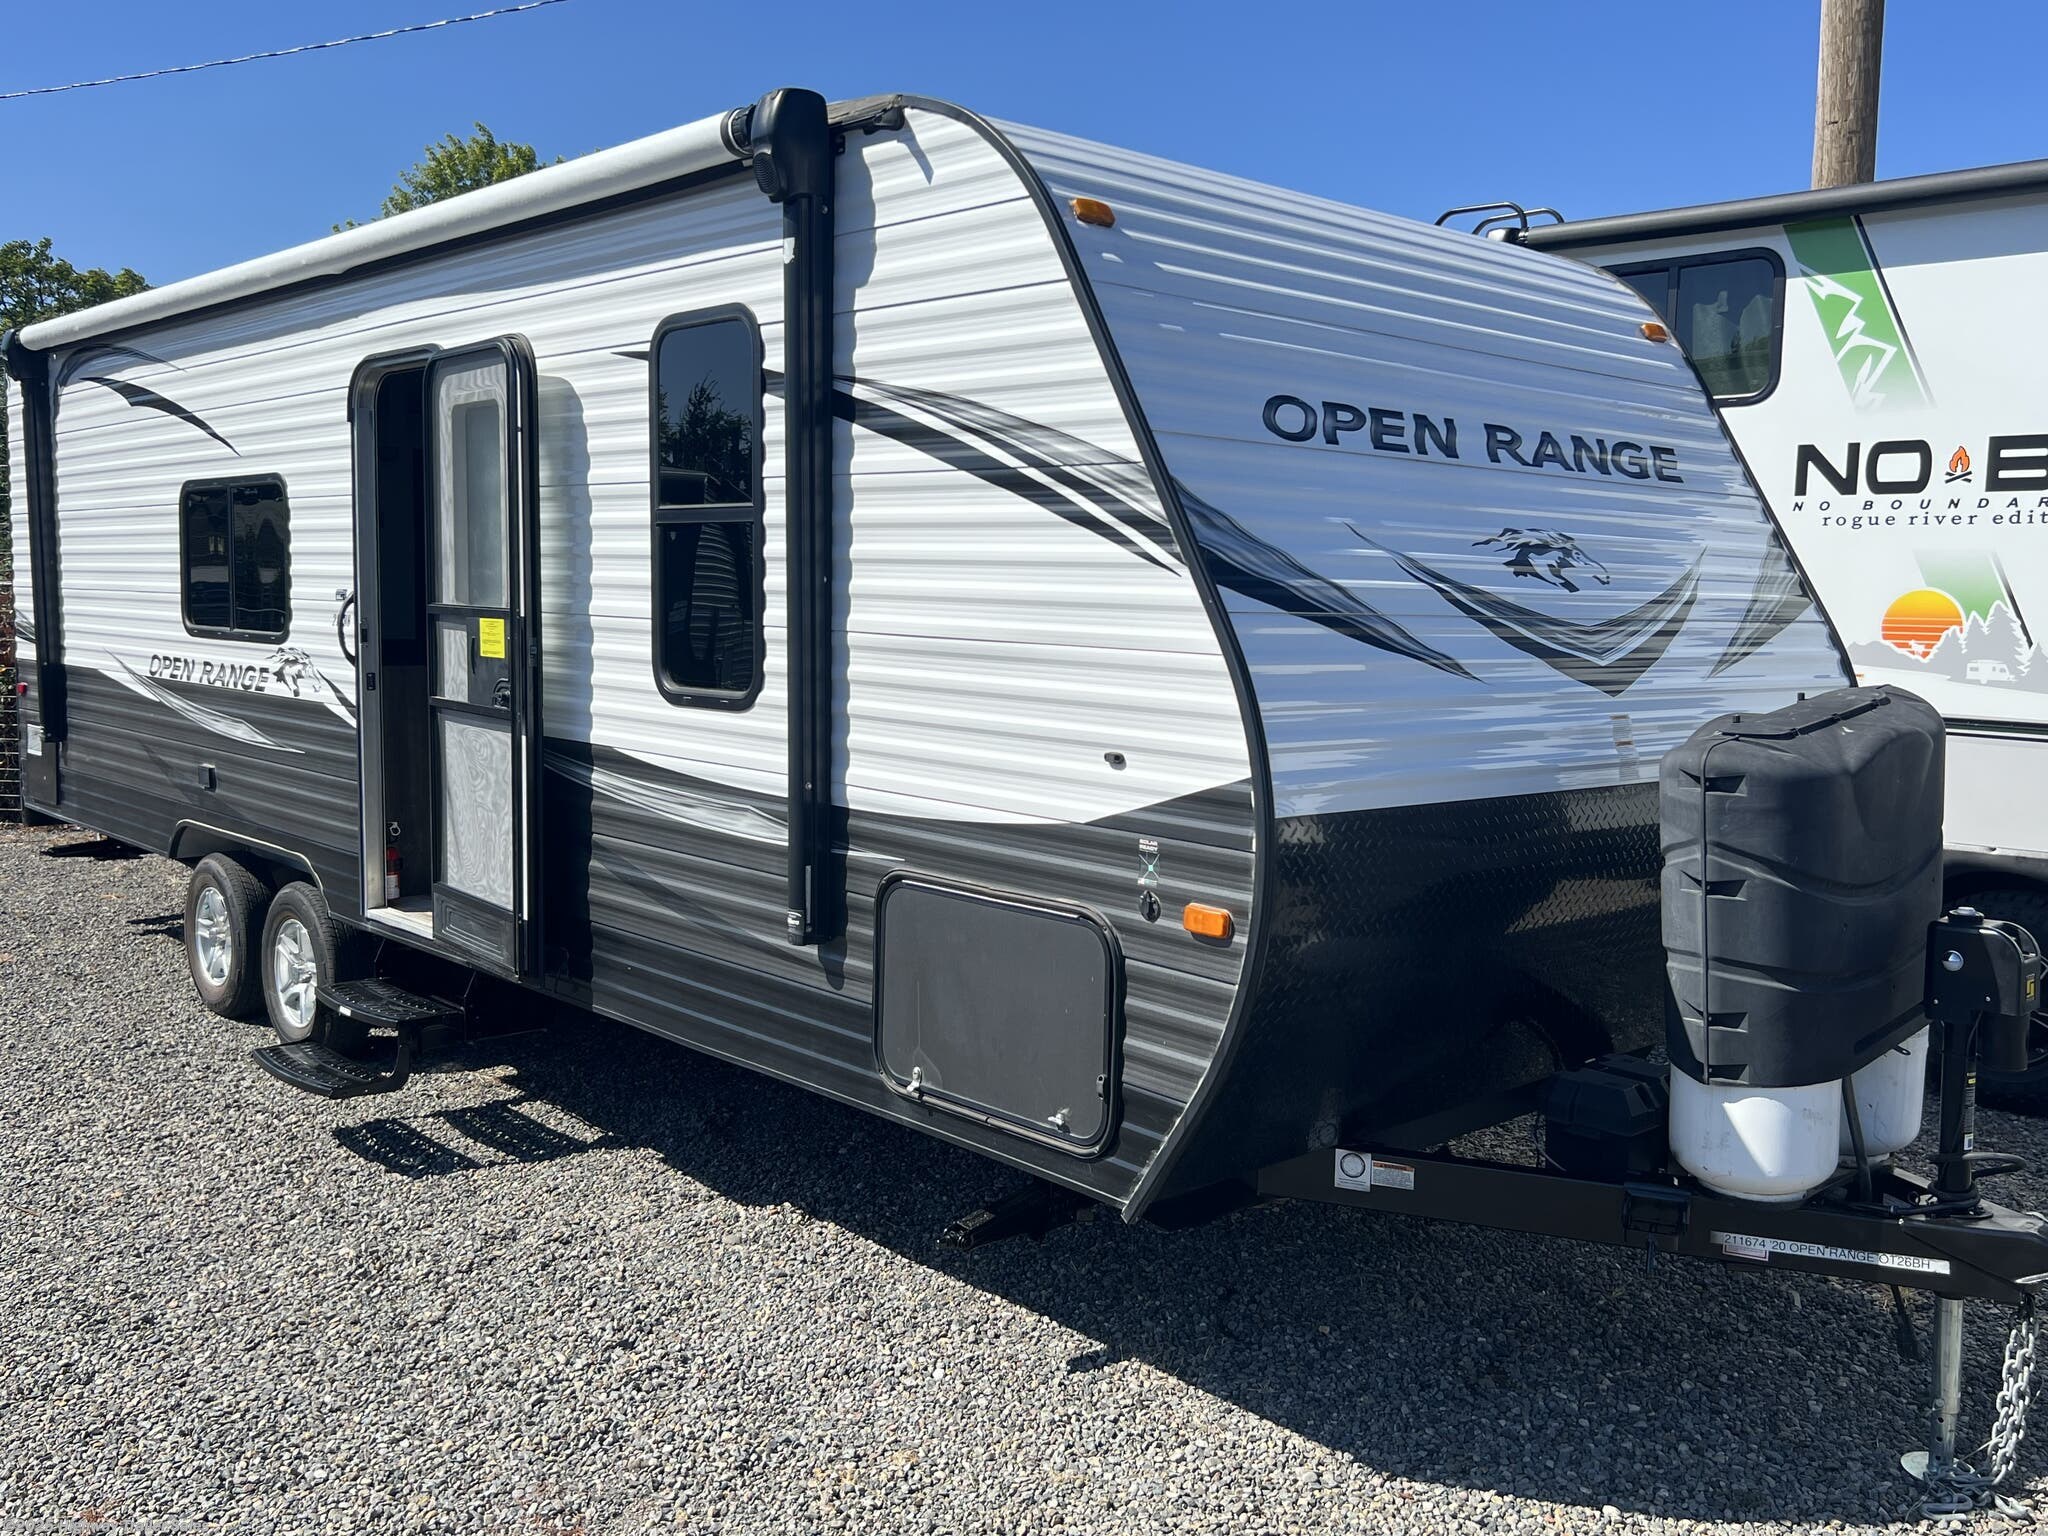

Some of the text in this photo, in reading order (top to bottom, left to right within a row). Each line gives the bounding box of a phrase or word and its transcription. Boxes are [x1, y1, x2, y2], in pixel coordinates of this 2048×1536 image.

[1262, 394, 1684, 484] OPEN RANGE
[1794, 439, 1933, 496] NO
[1793, 496, 2048, 512] NO BOUNDAR
[1822, 510, 2048, 530] rogue river edit
[149, 654, 270, 692] OPEN RANGE
[1724, 1234, 1930, 1269] 211674 '20 OPEN RANGE OT26BH
